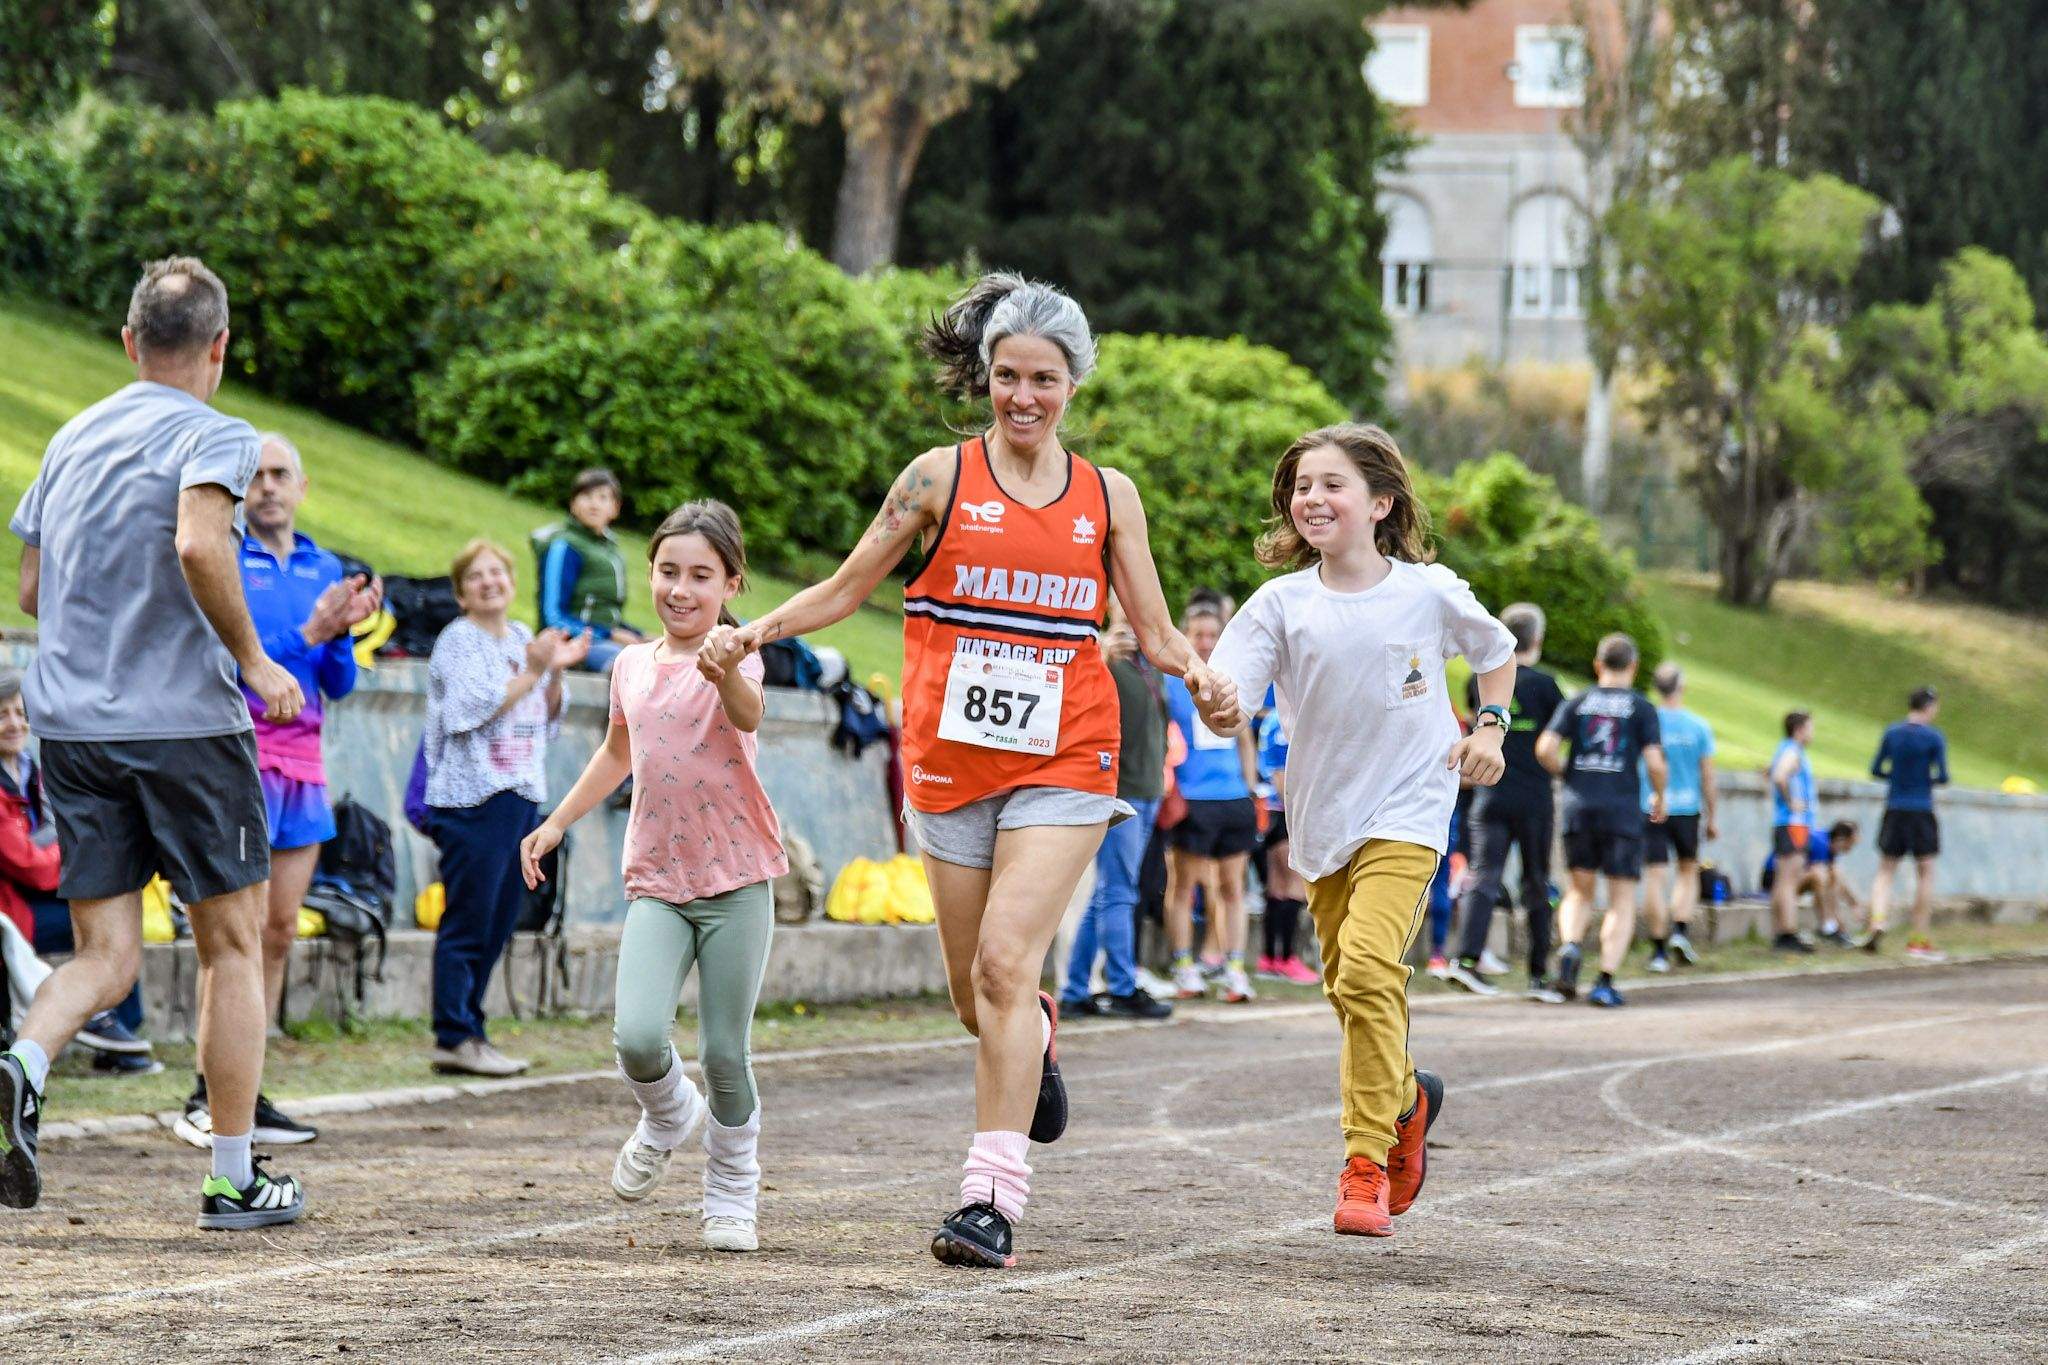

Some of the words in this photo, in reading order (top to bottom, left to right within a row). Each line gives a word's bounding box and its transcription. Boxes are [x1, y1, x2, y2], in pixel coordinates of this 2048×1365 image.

[952, 564, 1098, 612] MADRID
[956, 635, 1038, 664] VINTAGE
[964, 685, 1041, 730] 857
[1027, 737, 1050, 748] 2023
